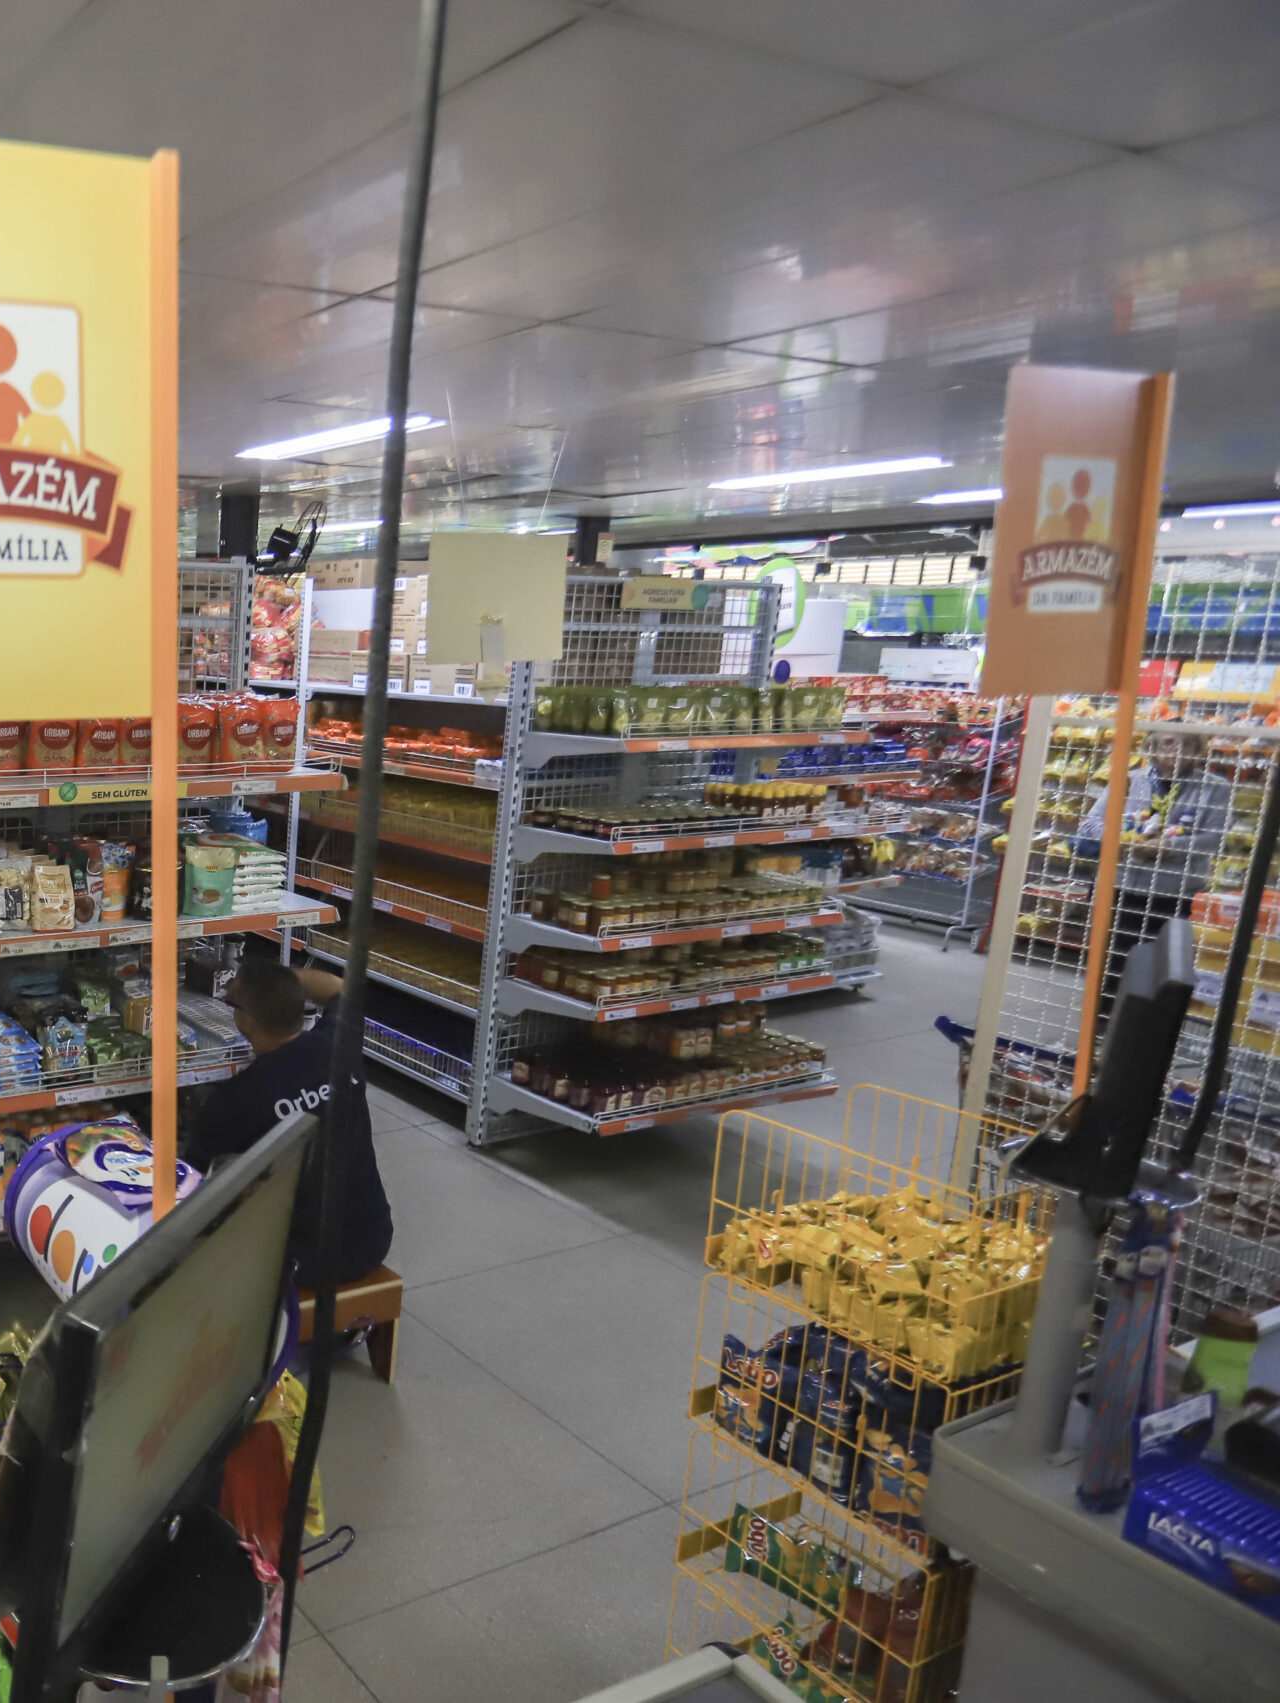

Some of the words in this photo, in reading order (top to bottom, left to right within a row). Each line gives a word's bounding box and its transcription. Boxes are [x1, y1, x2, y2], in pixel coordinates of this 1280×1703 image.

[1022, 545, 1113, 581] ARMAZÉM
[44, 727, 70, 738] URBANO
[131, 730, 152, 739] URBAN
[187, 729, 211, 739] URBANO
[91, 791, 111, 799] SEM
[112, 788, 148, 798] GLÚTEN
[274, 1083, 332, 1121] Orbe
[1147, 1511, 1215, 1556] LACTA
